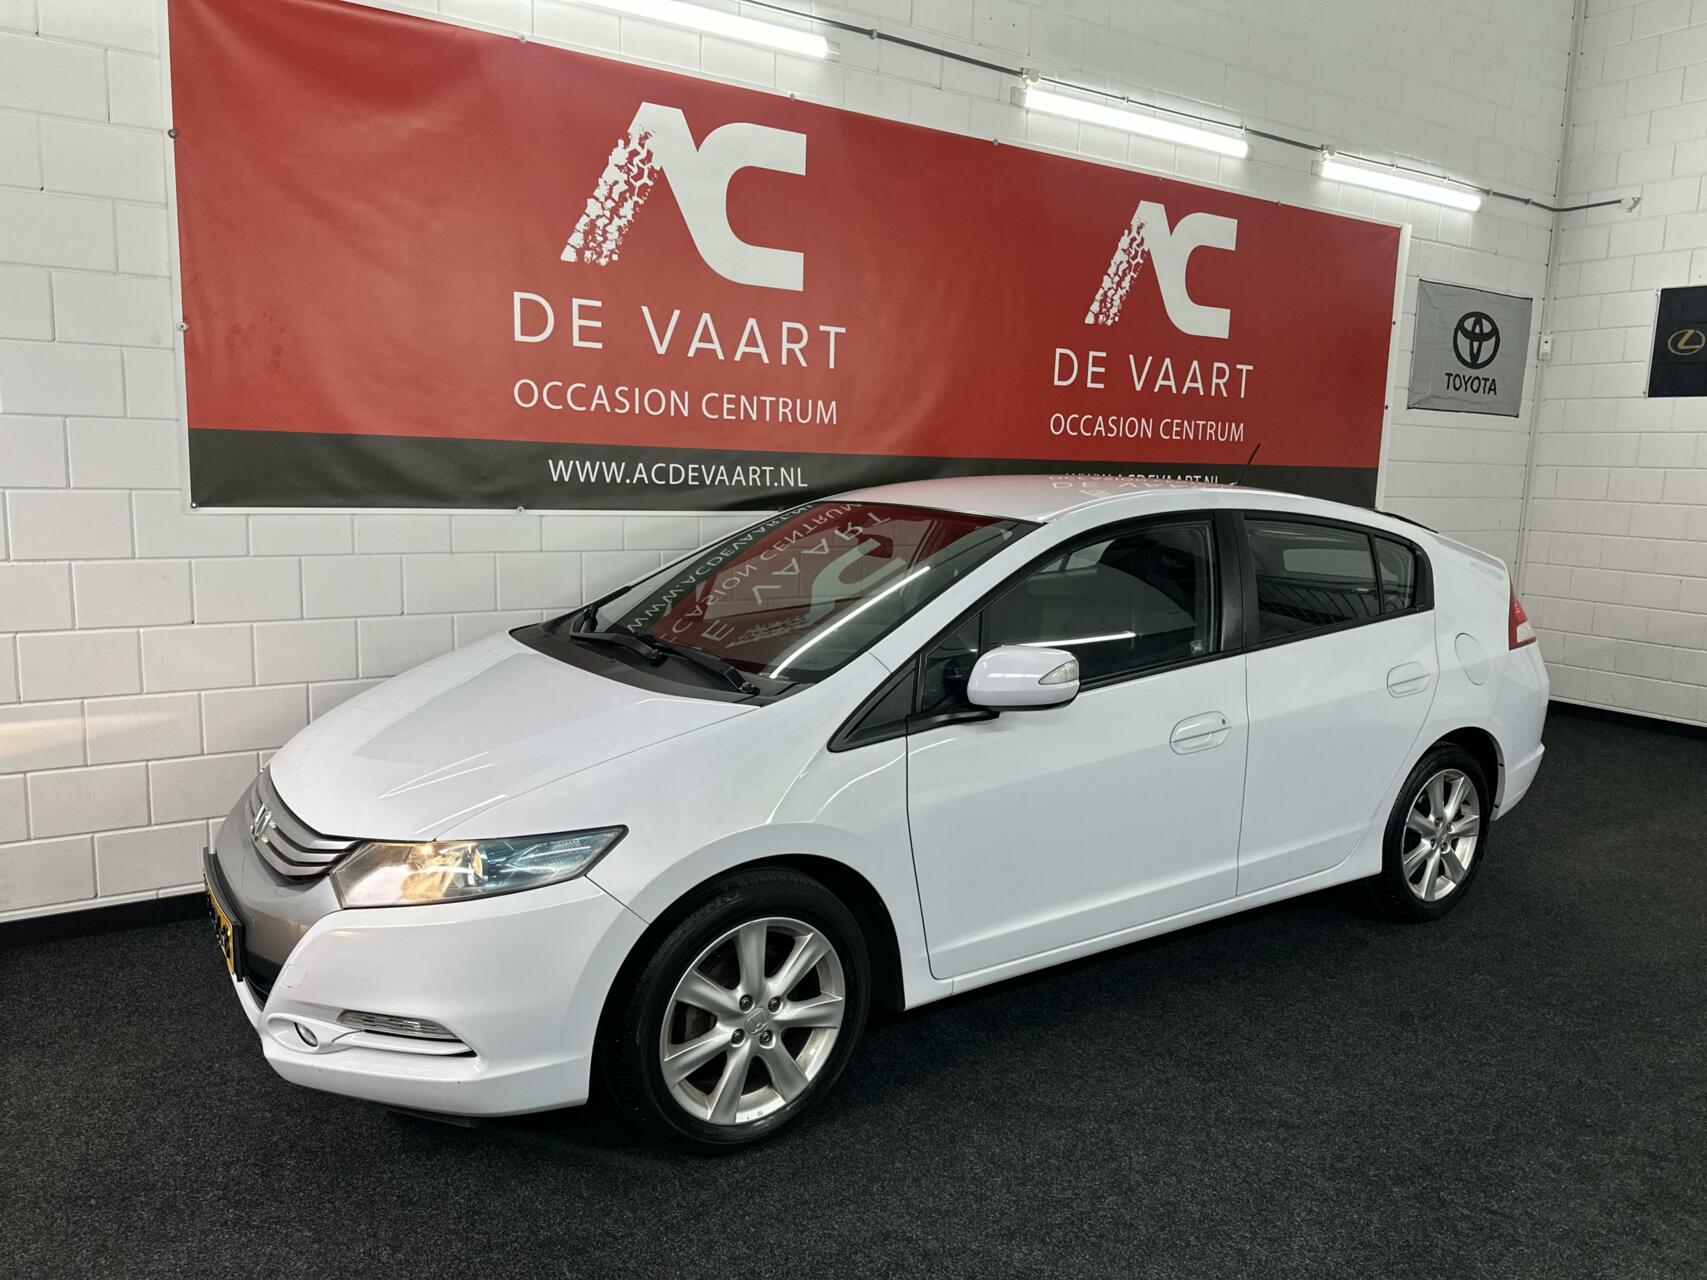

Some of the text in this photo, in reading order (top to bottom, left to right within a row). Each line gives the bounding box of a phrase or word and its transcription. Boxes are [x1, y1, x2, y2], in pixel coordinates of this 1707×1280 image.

[560, 101, 807, 292] AC
[1084, 199, 1238, 339] AC
[512, 290, 847, 370] DE VAART
[1053, 347, 1254, 399] DE VAART
[1445, 372, 1498, 396] TOYOTA
[513, 377, 839, 426] OCCASION CENTRUM
[1049, 413, 1245, 443] OCCASION CENTRUM
[548, 457, 808, 487] WWW.ACDEVAART.NL
